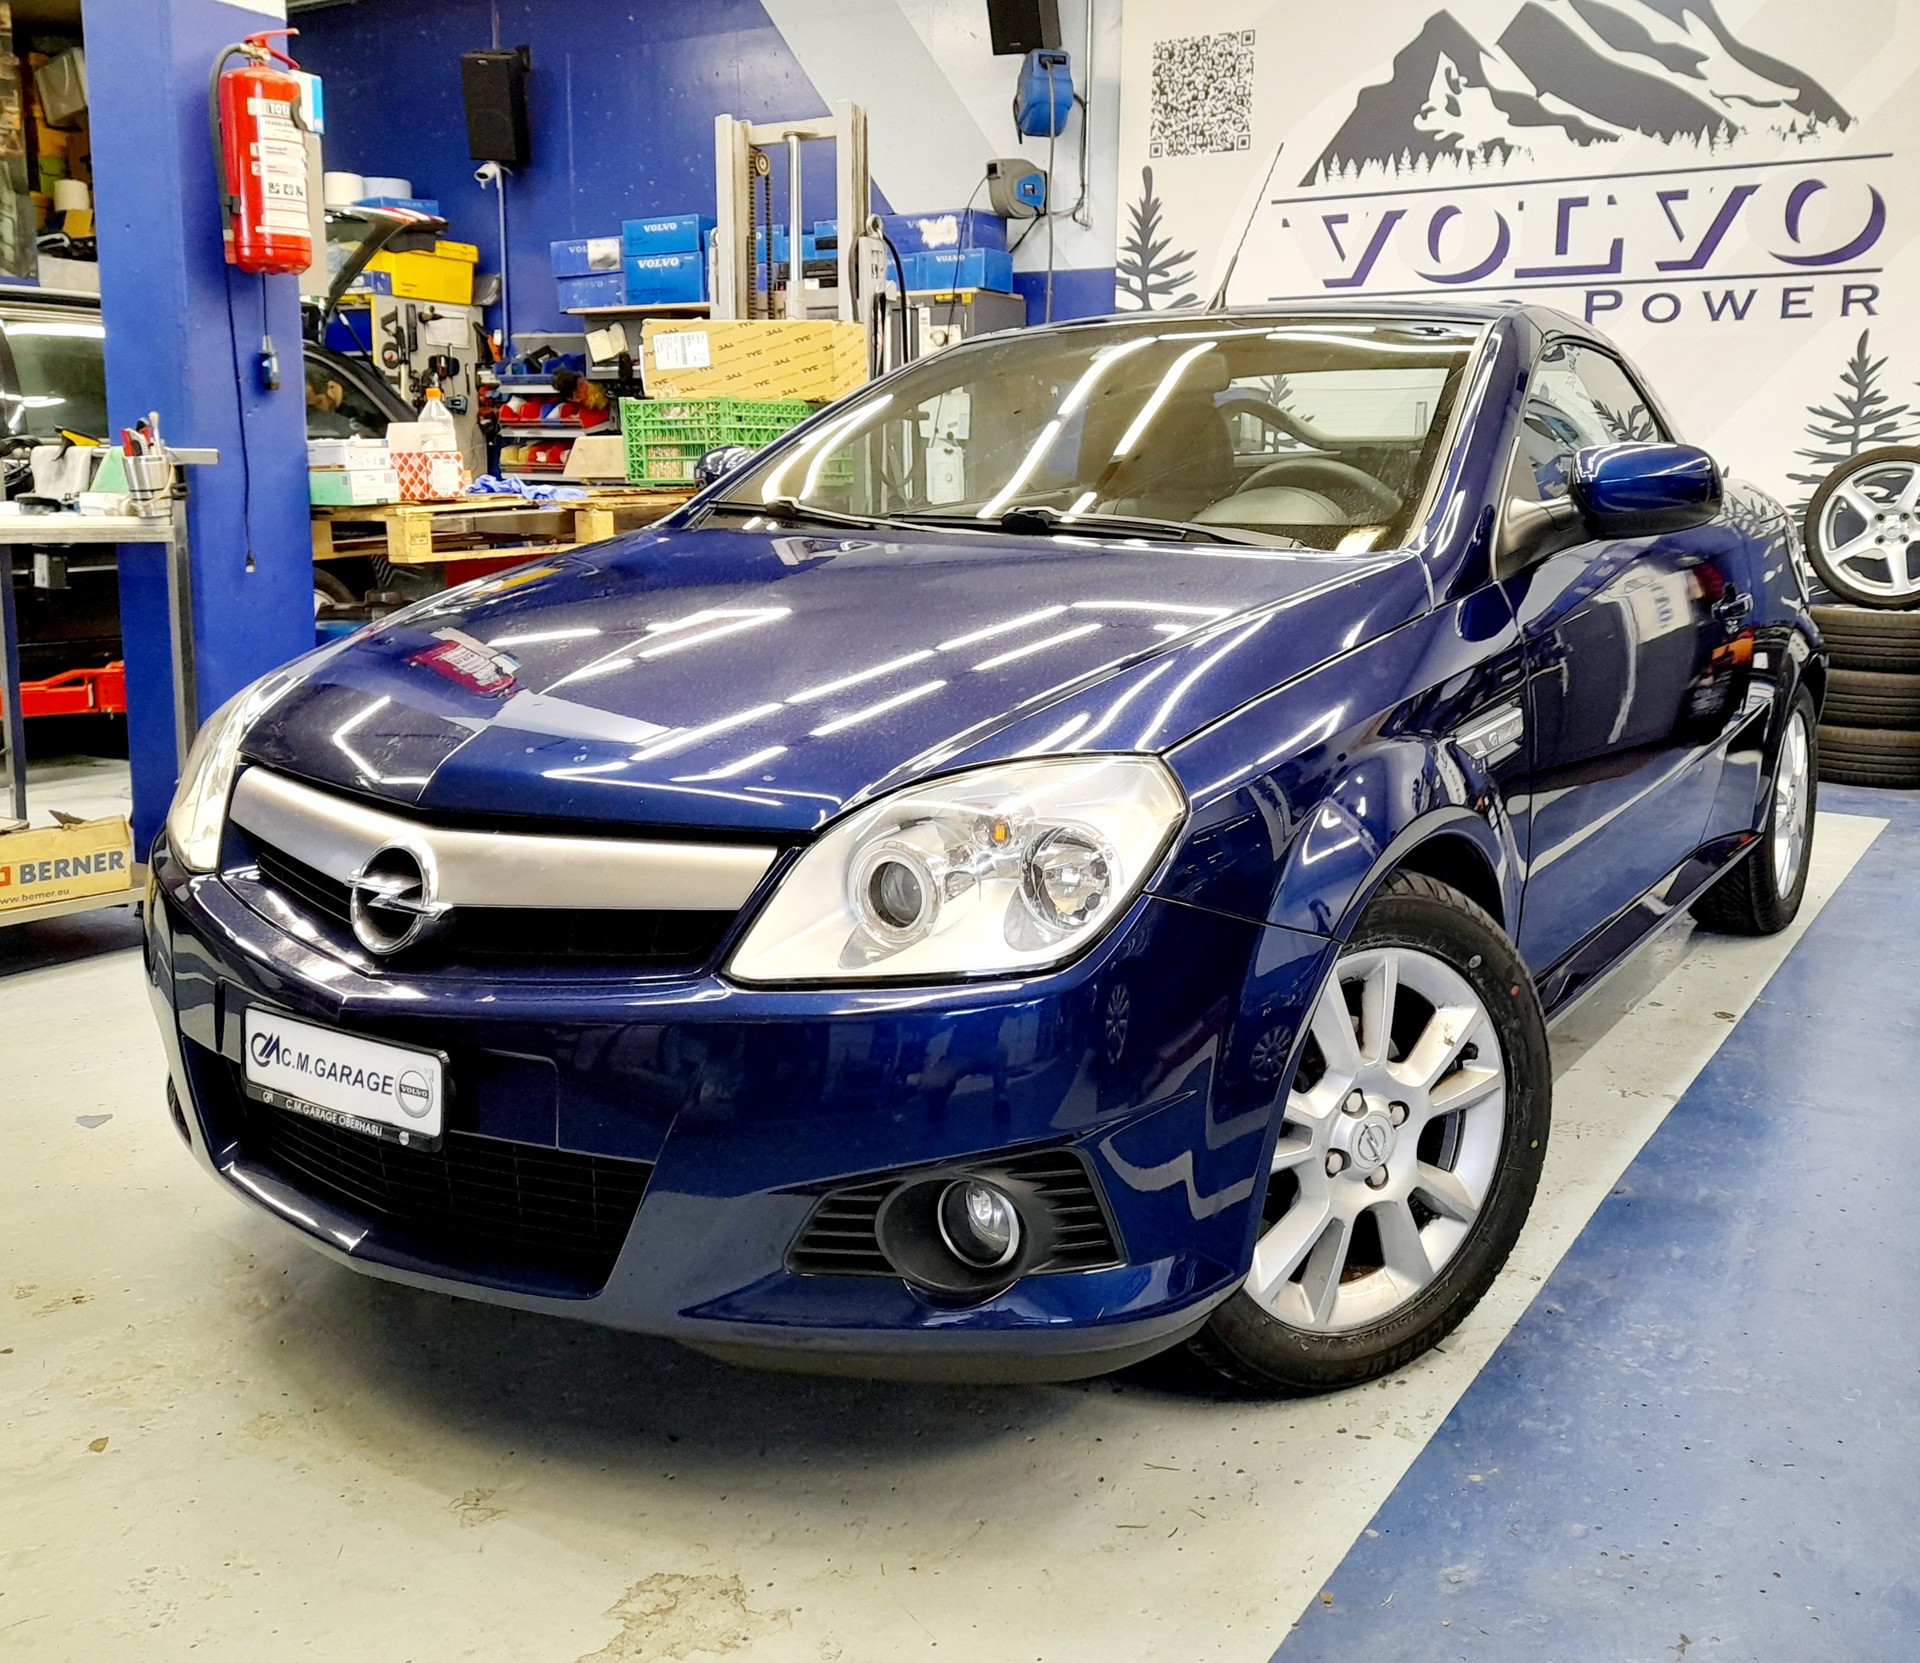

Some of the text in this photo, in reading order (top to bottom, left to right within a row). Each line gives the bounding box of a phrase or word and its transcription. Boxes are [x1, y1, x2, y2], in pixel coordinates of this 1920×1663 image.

[643, 222, 677, 233] VOLVO
[1281, 178, 1887, 288] VOLVO
[568, 244, 588, 254] VOL
[637, 257, 680, 269] VOLVO
[935, 253, 966, 262] VOLVO
[1584, 283, 1881, 323] POWER
[794, 334, 812, 344] TYC
[745, 349, 763, 358] TYC
[801, 364, 819, 374] TYC
[753, 379, 770, 388] TYC
[20, 850, 125, 885] BERNER
[281, 1047, 395, 1096] C.M.GARAGE
[400, 1085, 429, 1098] VOLVO
[338, 1115, 384, 1138] OBERHASLI
